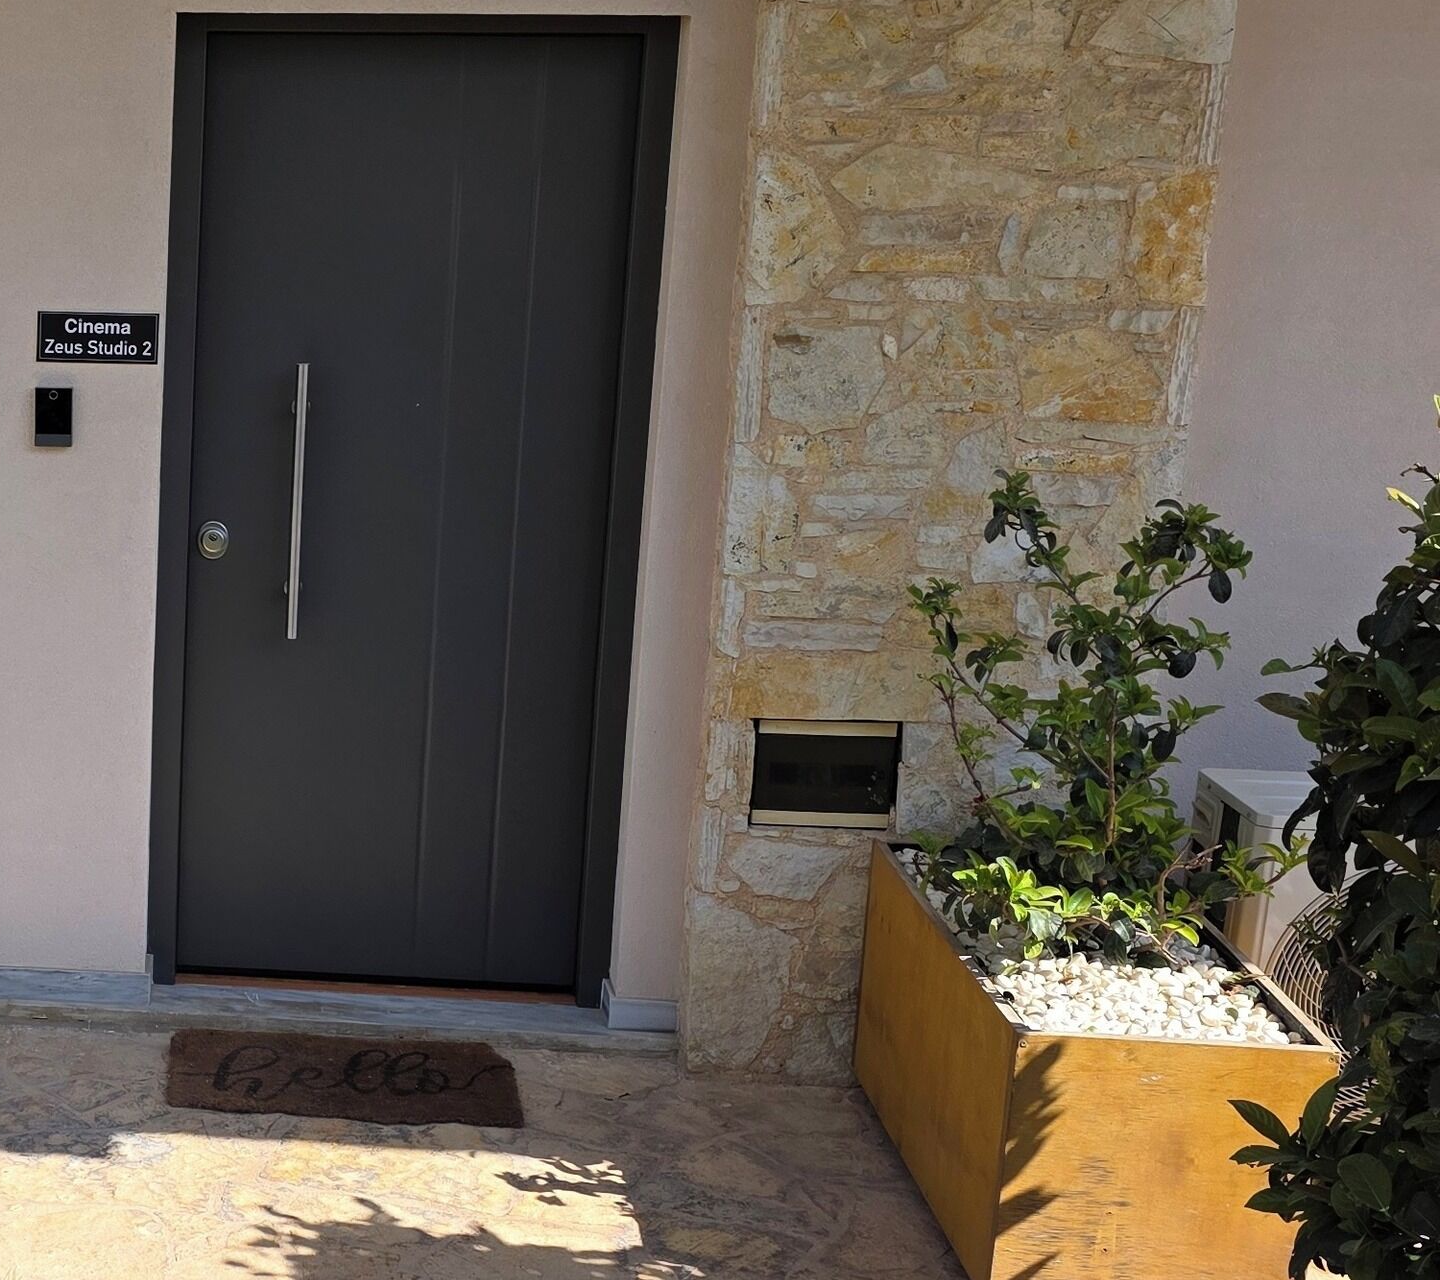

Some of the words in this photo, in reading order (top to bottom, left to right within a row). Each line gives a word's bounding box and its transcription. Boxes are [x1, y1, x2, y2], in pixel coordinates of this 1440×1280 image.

[64, 318, 131, 335] Cinema
[44, 339, 83, 354] Zeus
[87, 340, 138, 356] Studio
[142, 341, 152, 356] 2
